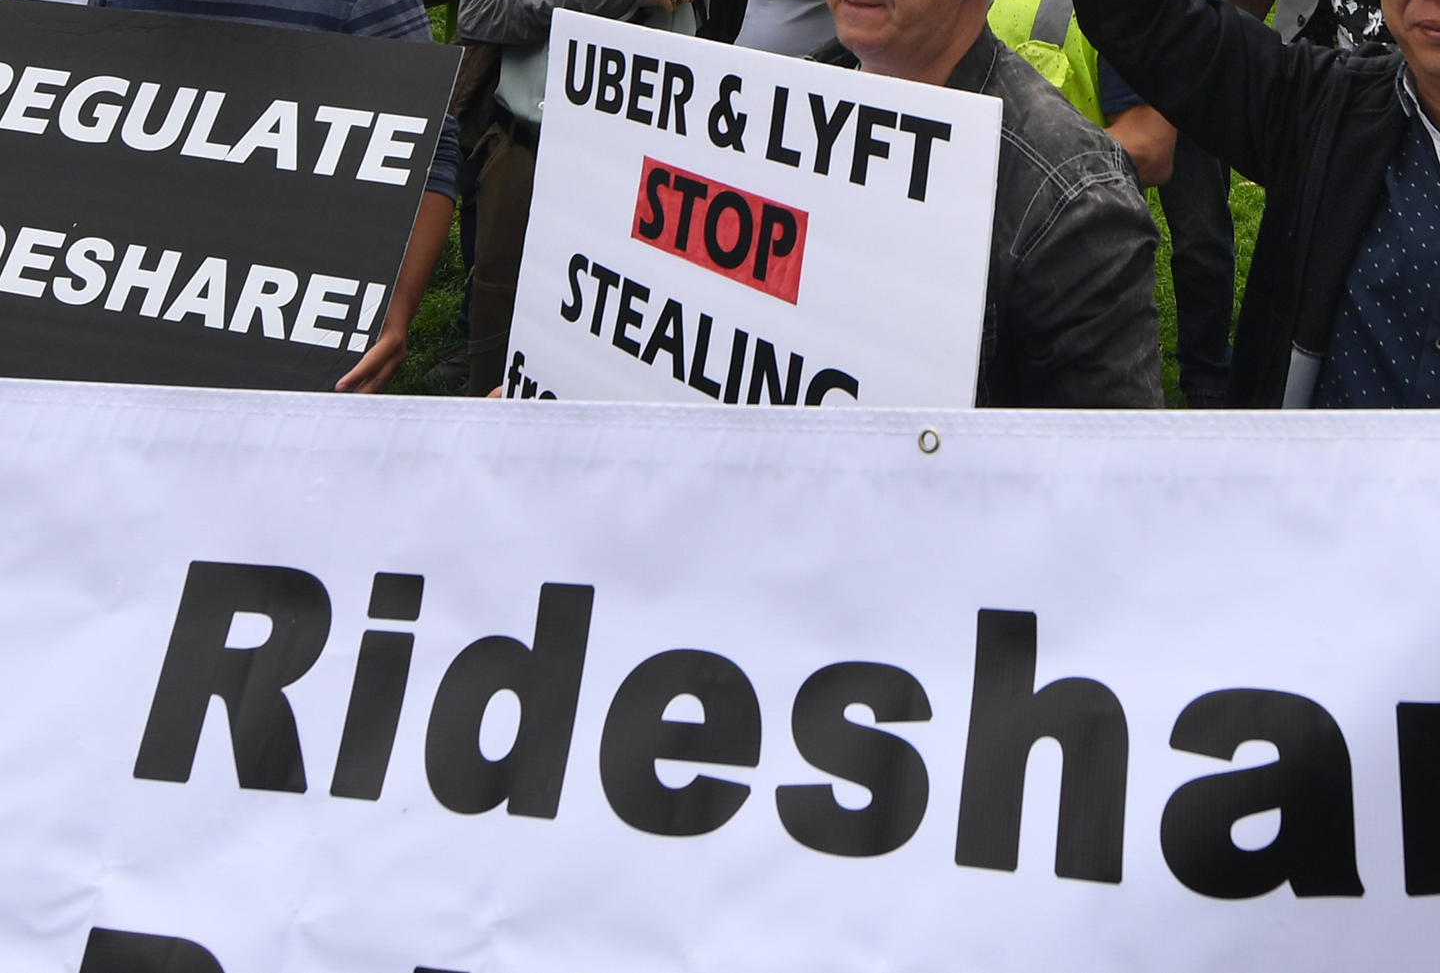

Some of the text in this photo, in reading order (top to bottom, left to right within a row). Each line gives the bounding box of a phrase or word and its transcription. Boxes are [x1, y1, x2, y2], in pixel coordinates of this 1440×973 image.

[564, 38, 952, 203] UBER & LYFT
[0, 222, 387, 353] ESHARE!
[638, 167, 797, 283] STOP
